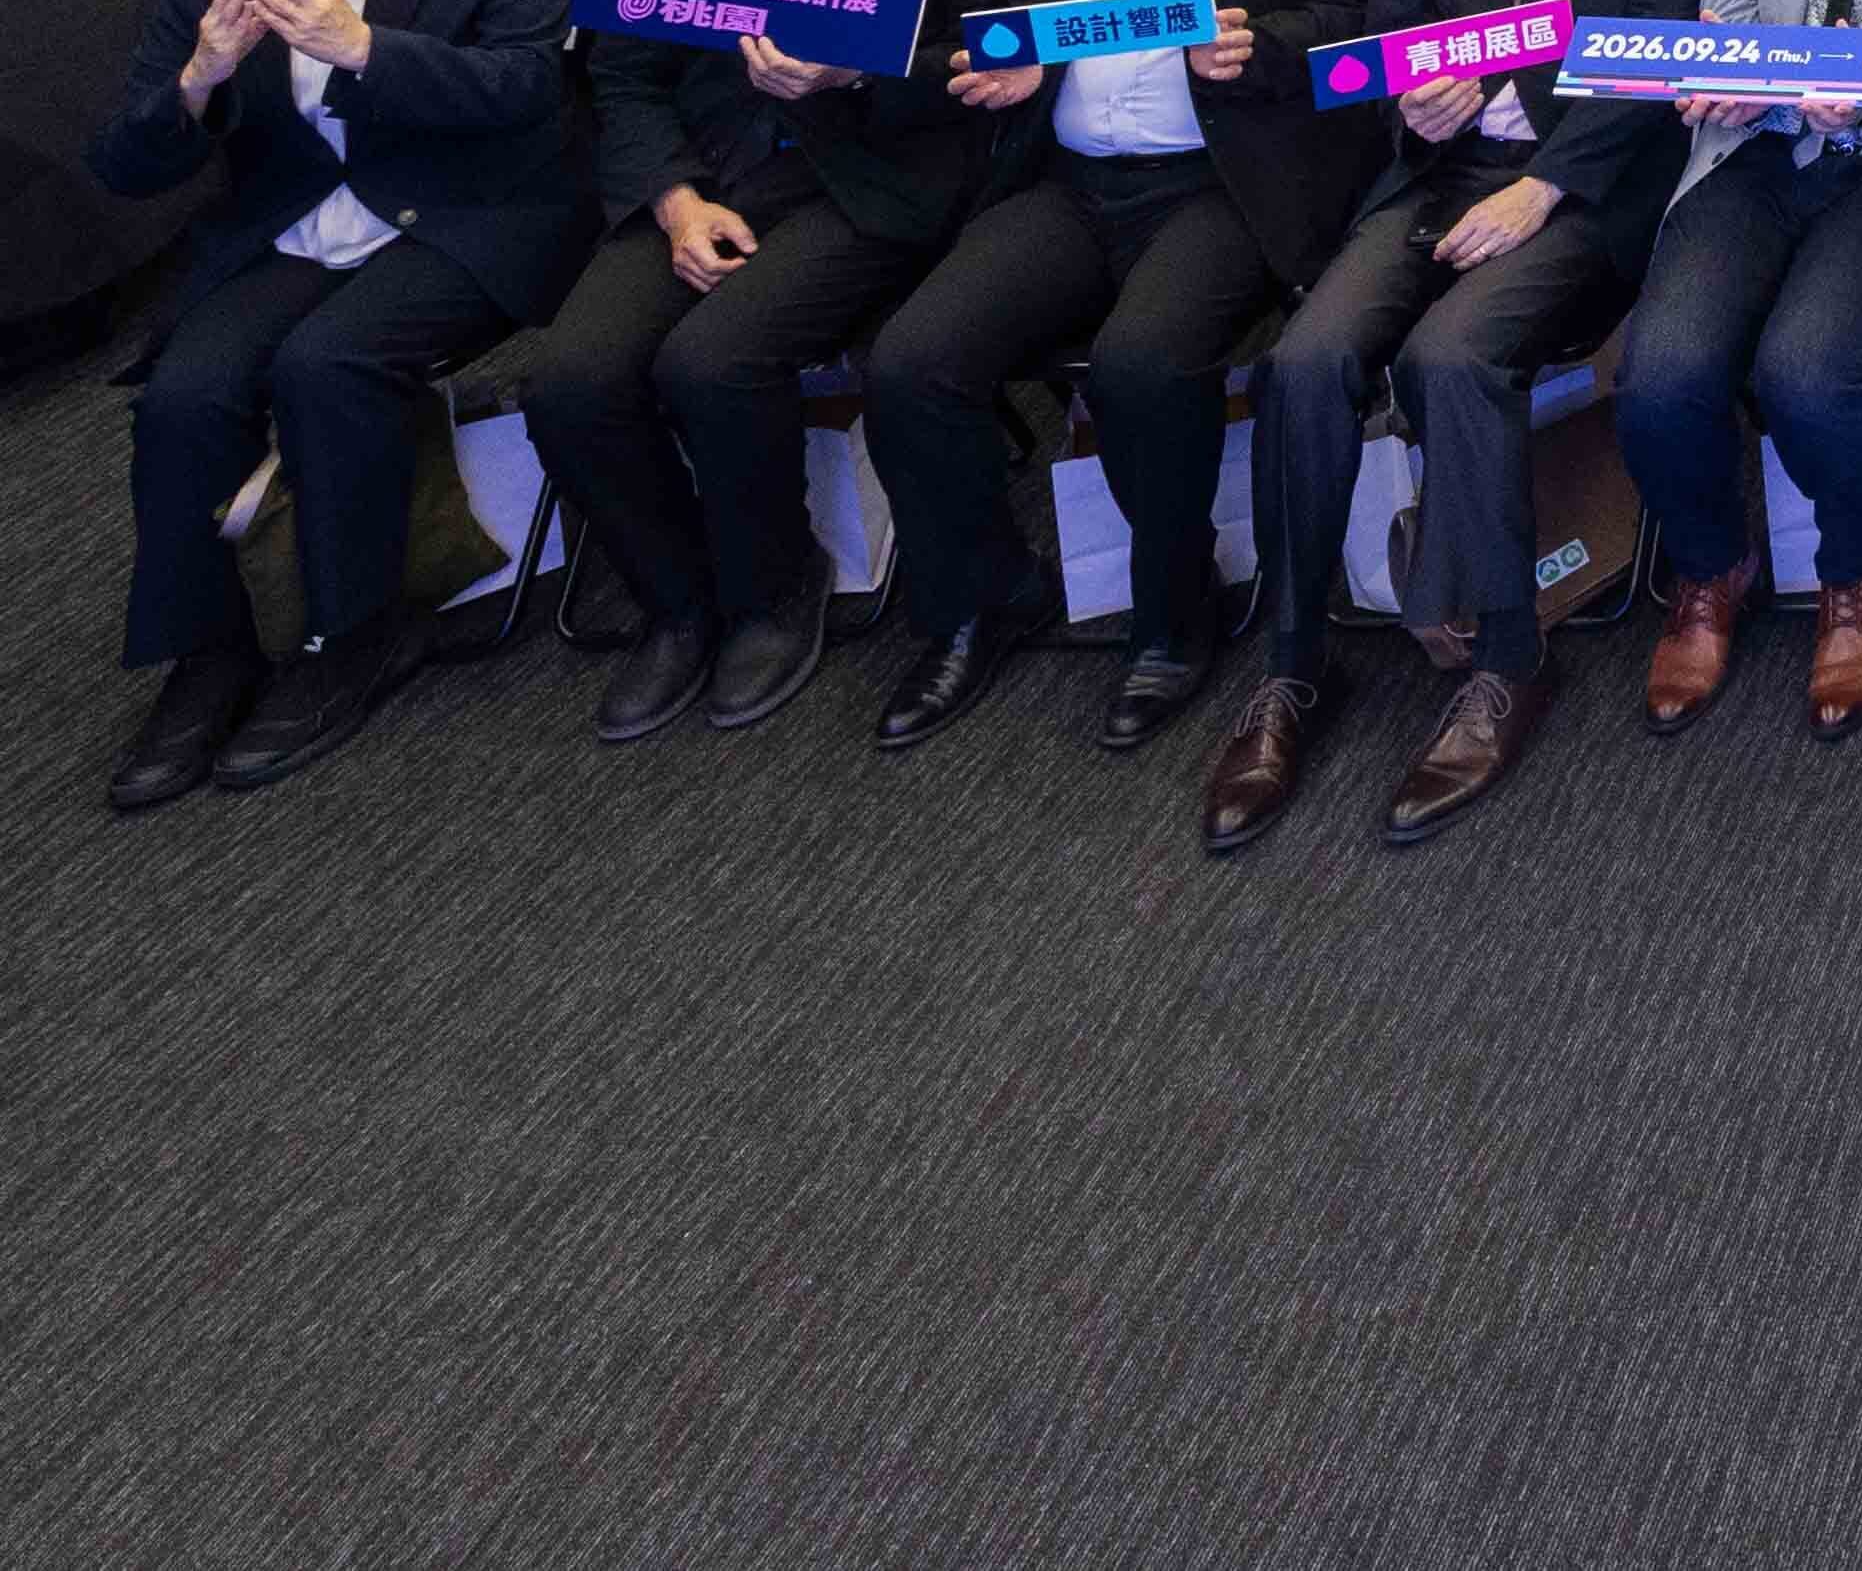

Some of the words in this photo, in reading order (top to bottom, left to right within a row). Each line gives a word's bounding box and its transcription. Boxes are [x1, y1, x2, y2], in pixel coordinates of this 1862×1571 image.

[1053, 2, 1200, 48] 設計響應
[1405, 14, 1560, 76] 青埔展區
[1582, 32, 1761, 65] 2026.09.24
[1767, 48, 1812, 65] (Thu.)
